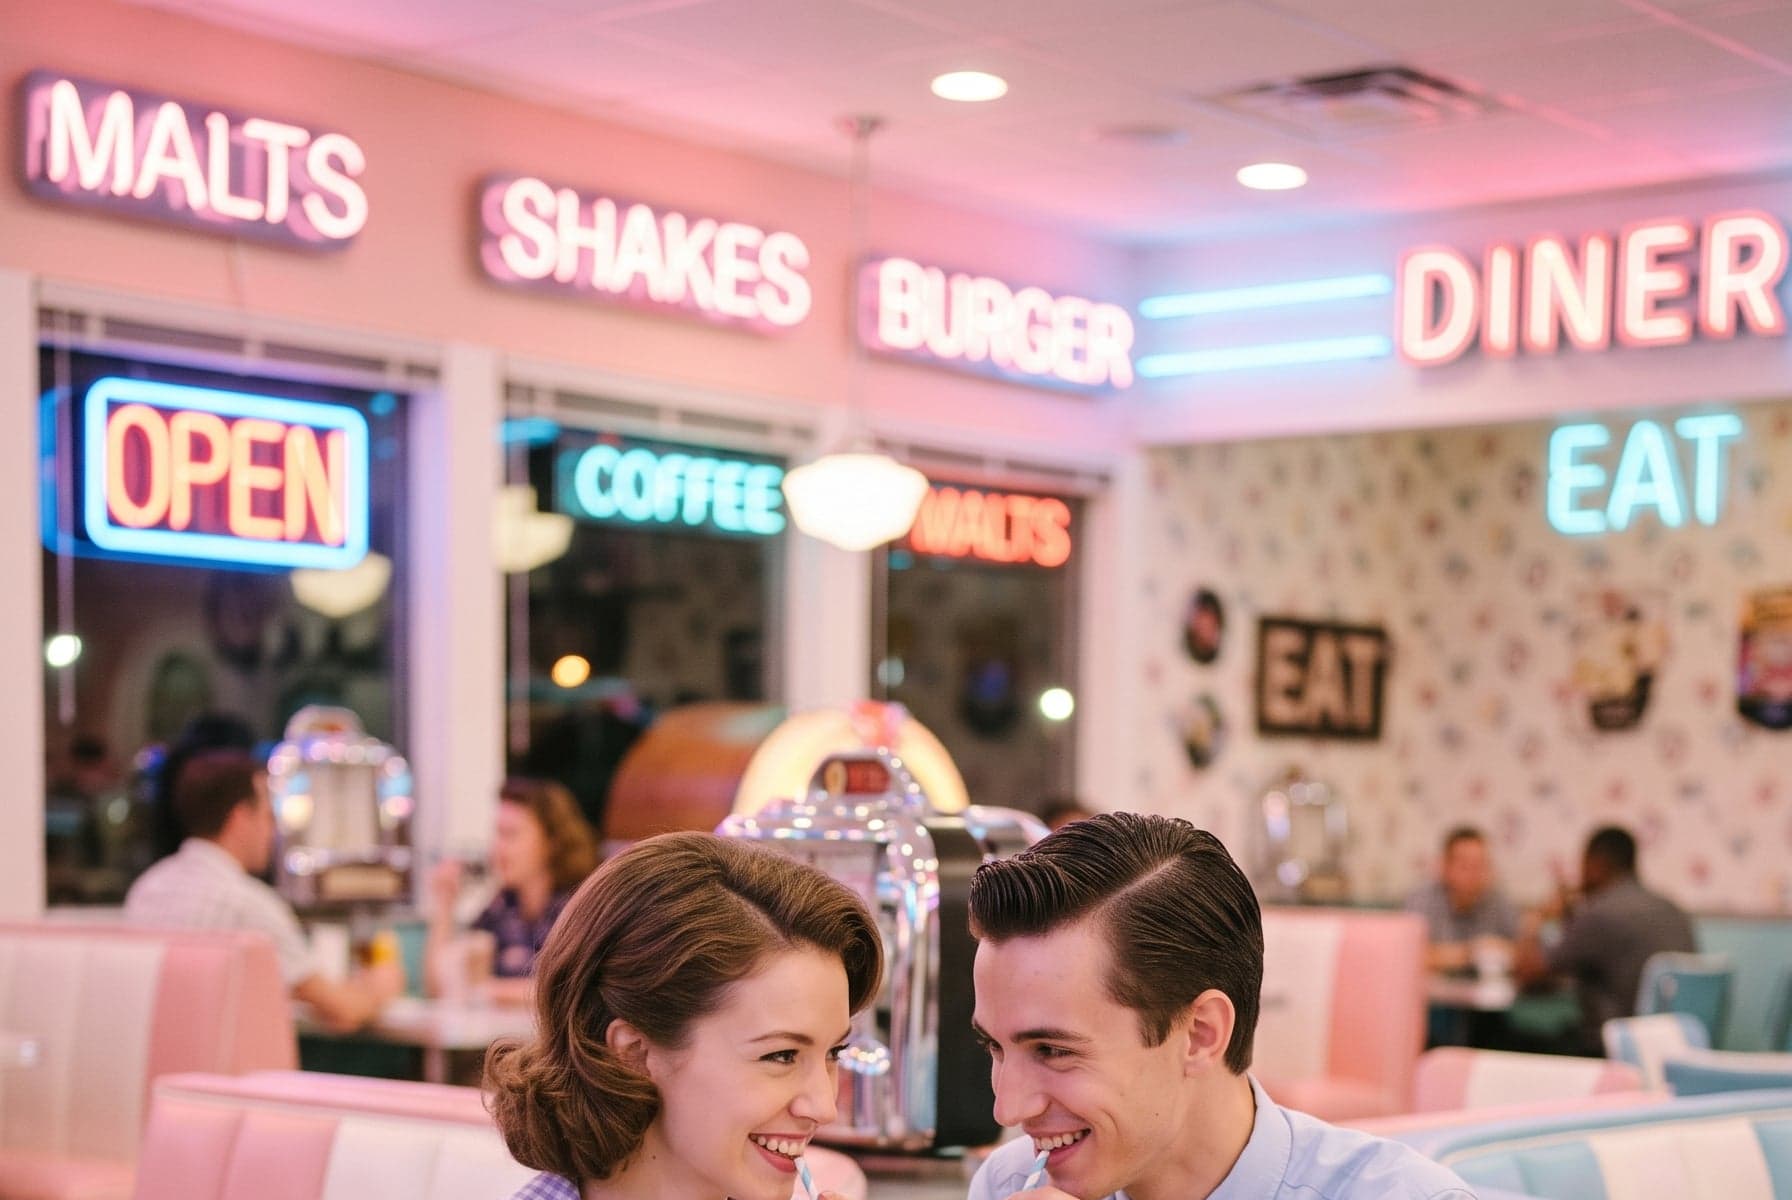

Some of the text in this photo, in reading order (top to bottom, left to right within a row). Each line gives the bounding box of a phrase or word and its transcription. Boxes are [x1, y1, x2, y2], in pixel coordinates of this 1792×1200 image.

[48, 79, 369, 240] MALTS
[500, 177, 811, 327] SHAKES
[1399, 209, 1789, 369] DINER
[877, 257, 1134, 389] BURGER
[104, 402, 349, 548] OPEN
[574, 444, 787, 536] COFFEE
[1546, 413, 1744, 536] EAT
[1264, 626, 1387, 727] EAT
